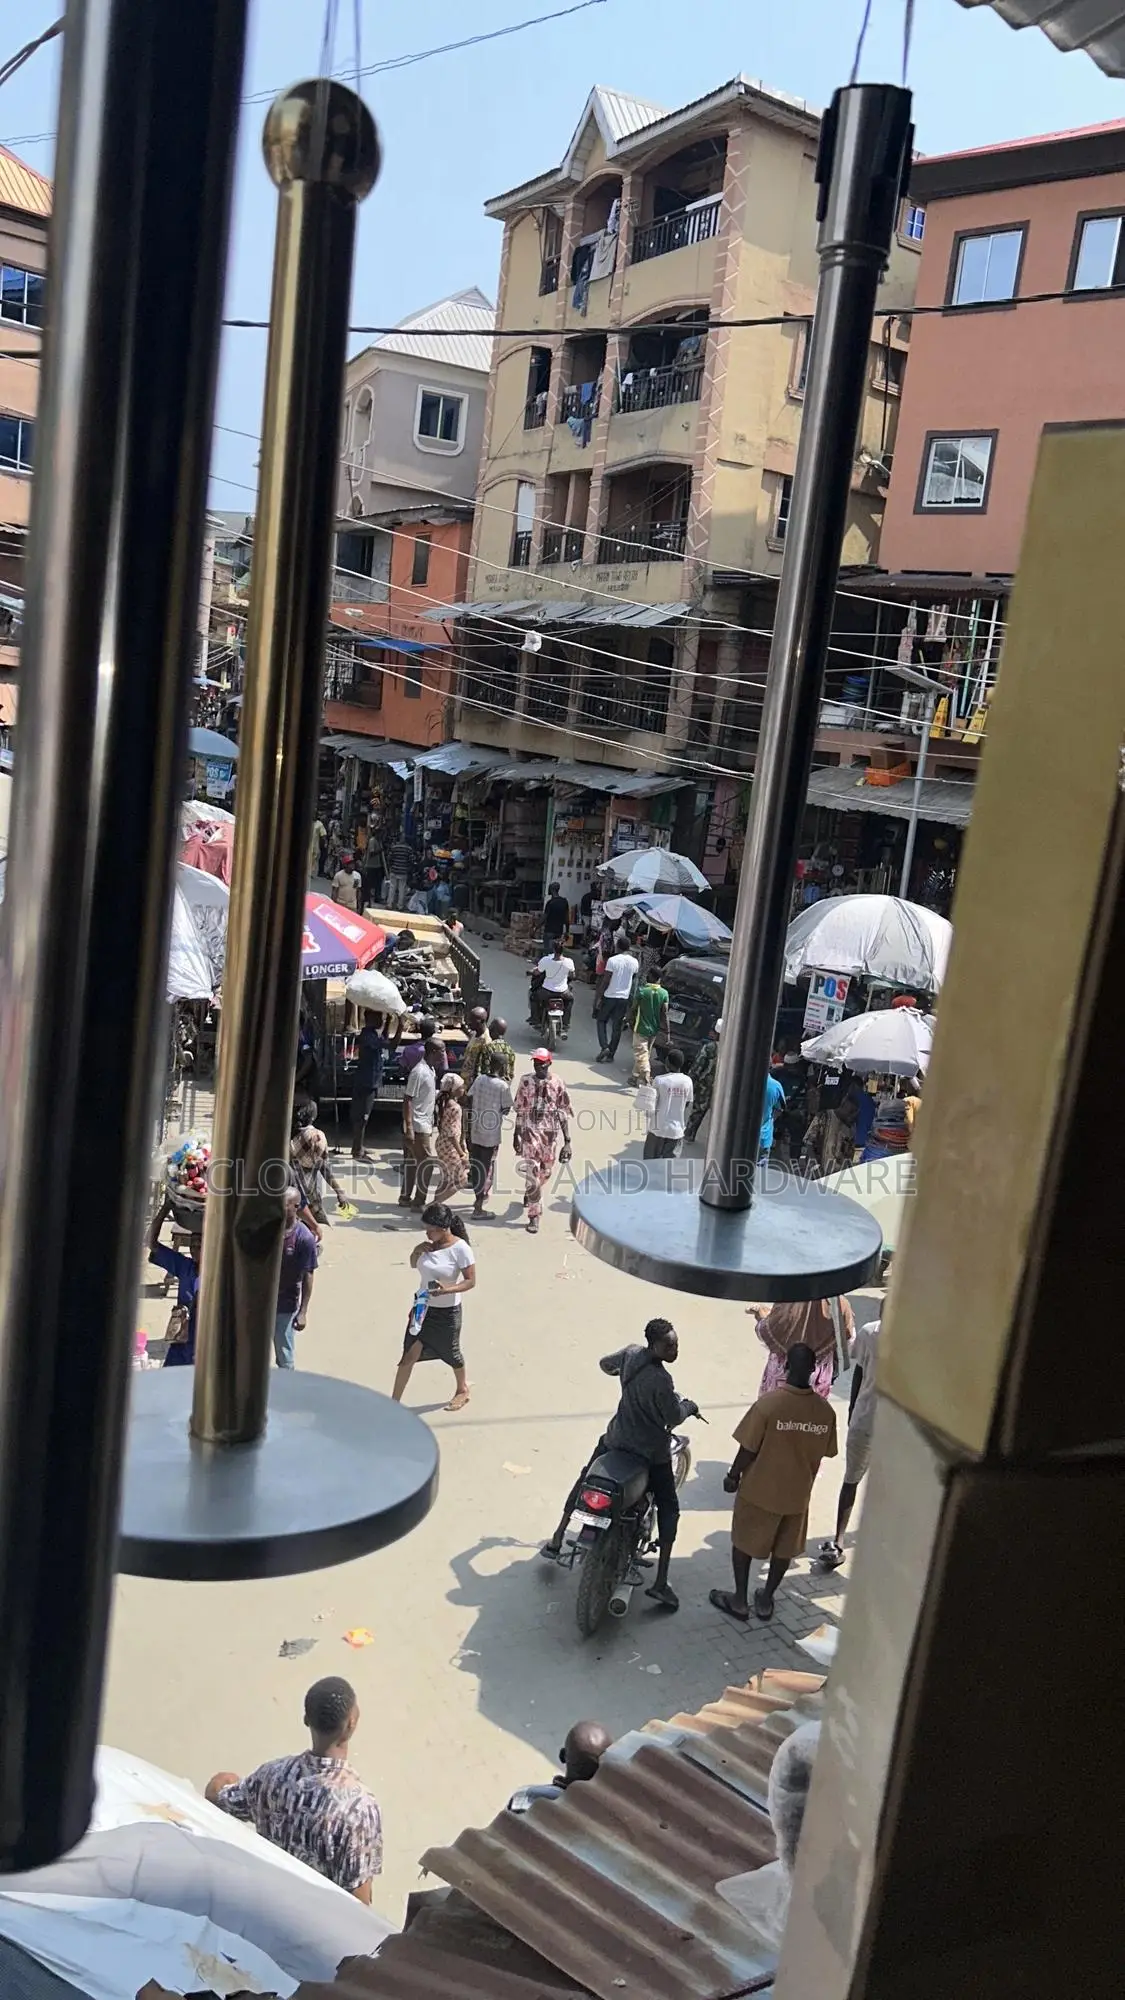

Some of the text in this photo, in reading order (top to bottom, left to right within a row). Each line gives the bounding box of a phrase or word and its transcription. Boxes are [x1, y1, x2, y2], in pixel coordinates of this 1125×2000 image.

[305, 963, 349, 976] LONGER
[812, 973, 848, 1001] POS
[776, 1419, 829, 1435] balenciaga
